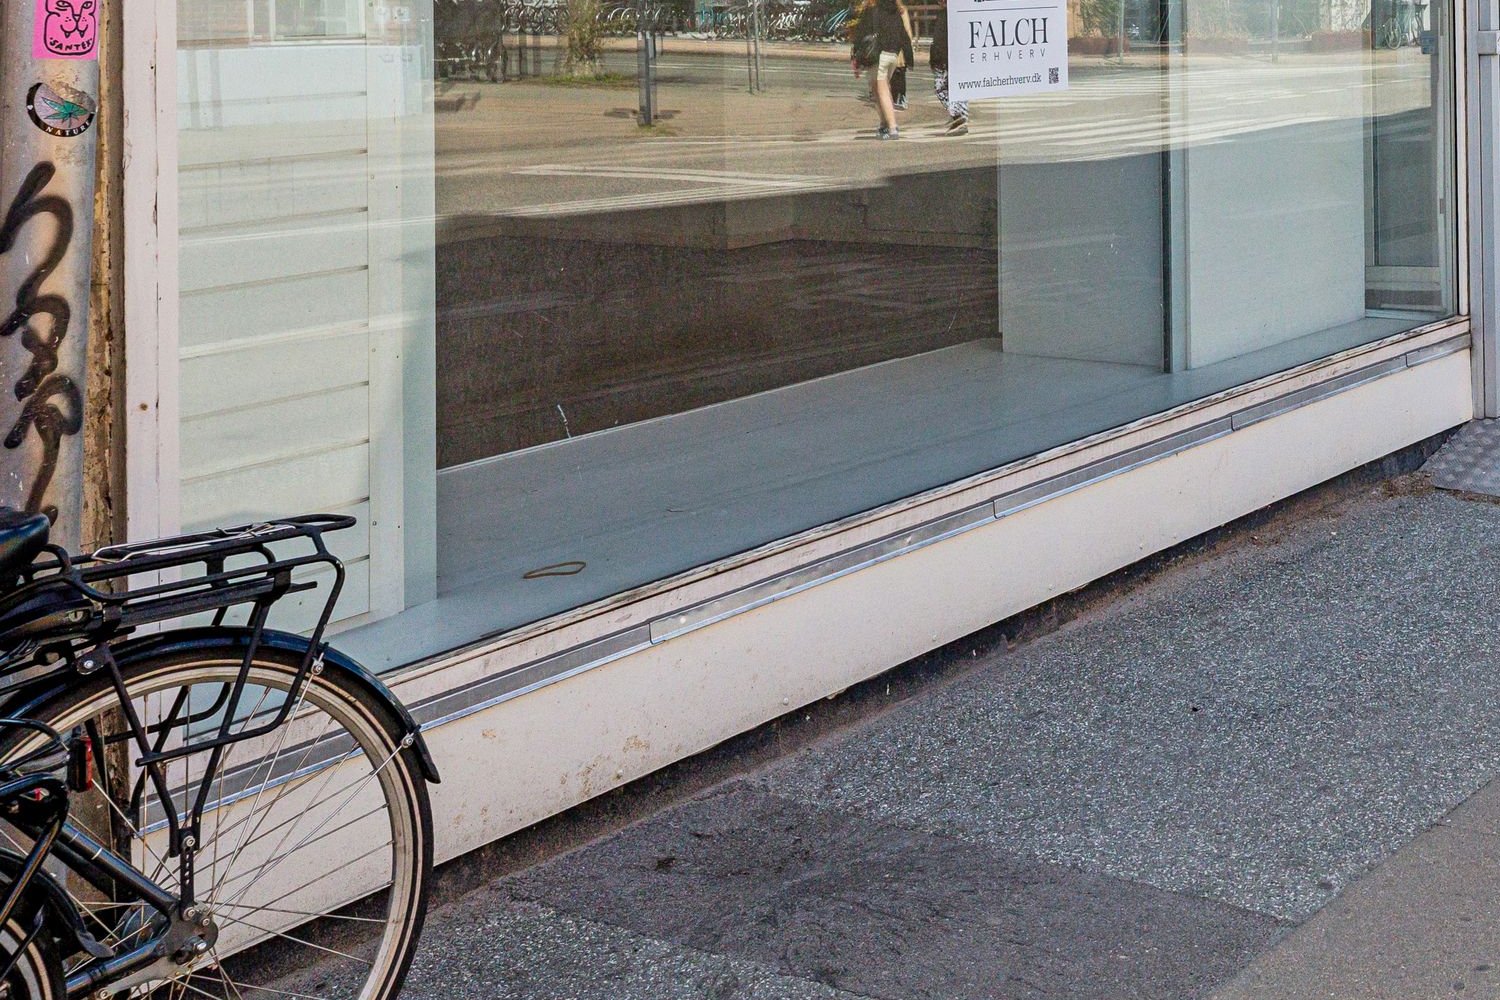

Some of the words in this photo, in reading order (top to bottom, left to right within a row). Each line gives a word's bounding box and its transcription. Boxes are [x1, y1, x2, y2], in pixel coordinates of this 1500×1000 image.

[968, 17, 1048, 48] FALCH
[970, 49, 1047, 64] ERHVERV
[958, 72, 1042, 90] www.falcherhverv.dk
